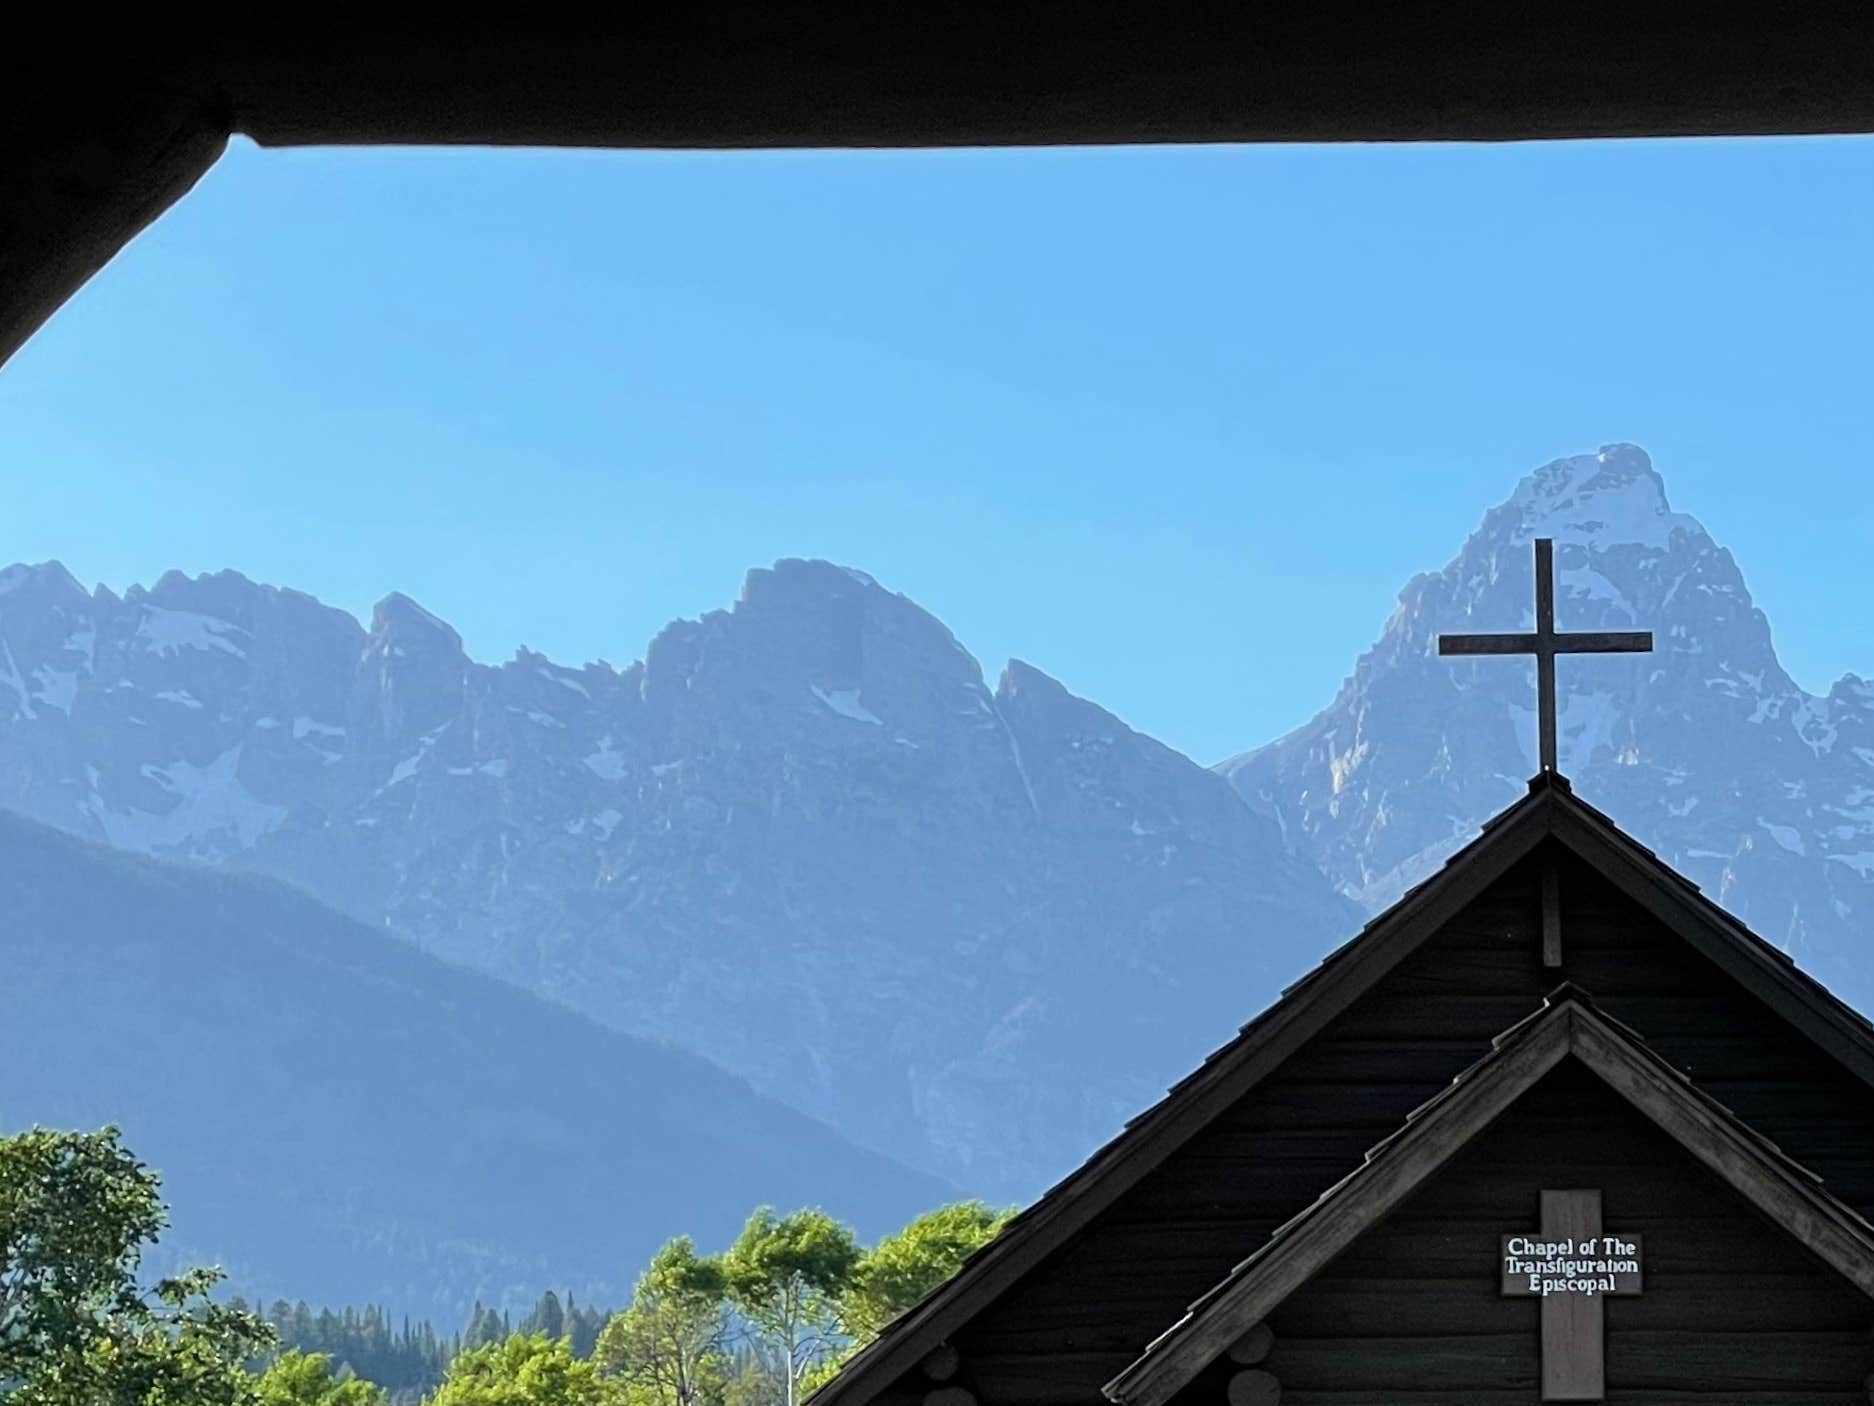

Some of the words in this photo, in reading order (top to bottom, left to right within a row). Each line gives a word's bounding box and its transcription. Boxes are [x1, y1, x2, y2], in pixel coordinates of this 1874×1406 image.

[1508, 1238, 1573, 1260] Chapel
[1579, 1238, 1597, 1255] of
[1603, 1238, 1636, 1255] The
[1505, 1256, 1638, 1278] Transfiguration
[1529, 1274, 1616, 1296] Episcopal
